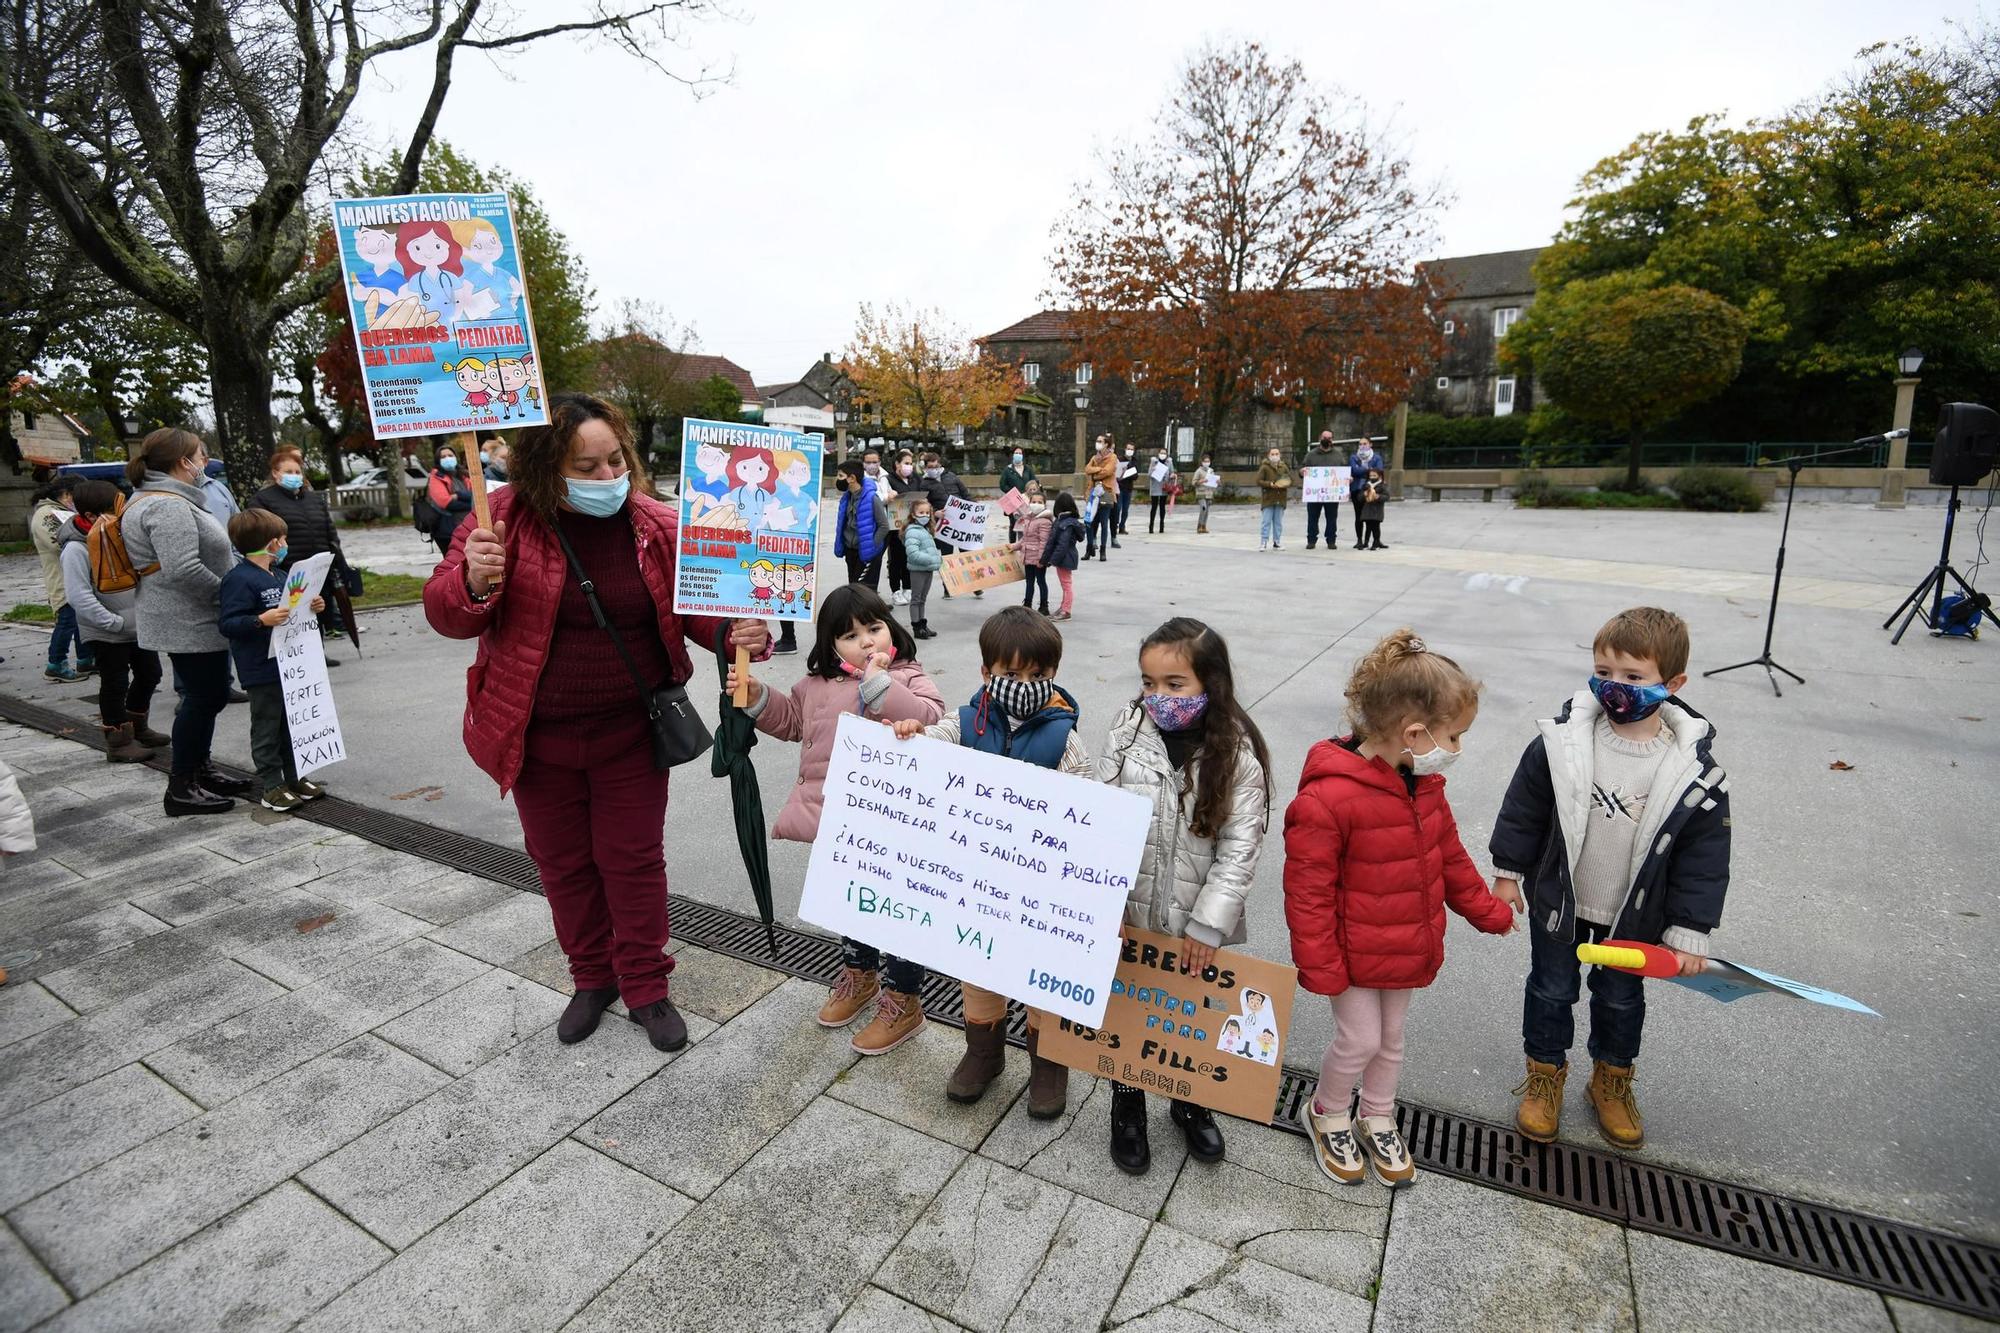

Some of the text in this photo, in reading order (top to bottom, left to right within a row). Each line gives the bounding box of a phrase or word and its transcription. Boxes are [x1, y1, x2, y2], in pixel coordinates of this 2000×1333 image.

[338, 197, 471, 226] MANIFESTACIÓN
[359, 324, 525, 349] QUEREMOS PEDIATRA
[364, 346, 436, 367] NA LAMA
[370, 377, 422, 388] Defendamos
[372, 387, 418, 398] os dereitos
[375, 408, 396, 418] fillos
[404, 406, 426, 415] fillas
[390, 398, 416, 406] nosos
[377, 424, 396, 434] ANPA
[412, 422, 424, 430] DO
[457, 418, 472, 426] CEIP
[480, 416, 500, 424] LAMA
[688, 424, 792, 451] MANIFESTACIÓN
[681, 542, 737, 559] NA LAMA
[682, 525, 810, 555] QUEREMOS PEDIATRA
[681, 566, 722, 574] Defendamos
[690, 574, 718, 582] dereitos
[702, 590, 720, 598] fillas
[288, 644, 304, 658] QUE
[284, 666, 306, 680] NOS
[286, 682, 322, 706] PERTE
[289, 704, 320, 726] NECE
[945, 772, 965, 791] YA
[975, 784, 994, 798] DE
[1002, 788, 1048, 814] PONER
[1064, 808, 1092, 826] AL
[846, 794, 937, 833] DESMANTELAR
[949, 830, 968, 847] LA
[847, 771, 1068, 852] COVID19 DE EXCUSA PARA
[832, 851, 848, 864] EL
[906, 878, 948, 900] DERECHO
[958, 896, 966, 908] A
[976, 903, 1012, 922] TENER
[897, 852, 964, 883] NUESTROS
[1020, 896, 1040, 910] NO
[956, 923, 994, 960] YA!
[1028, 968, 1095, 1006] 090481
[1146, 1014, 1207, 1041] PARA
[1098, 1054, 1192, 1097] A LAMA
